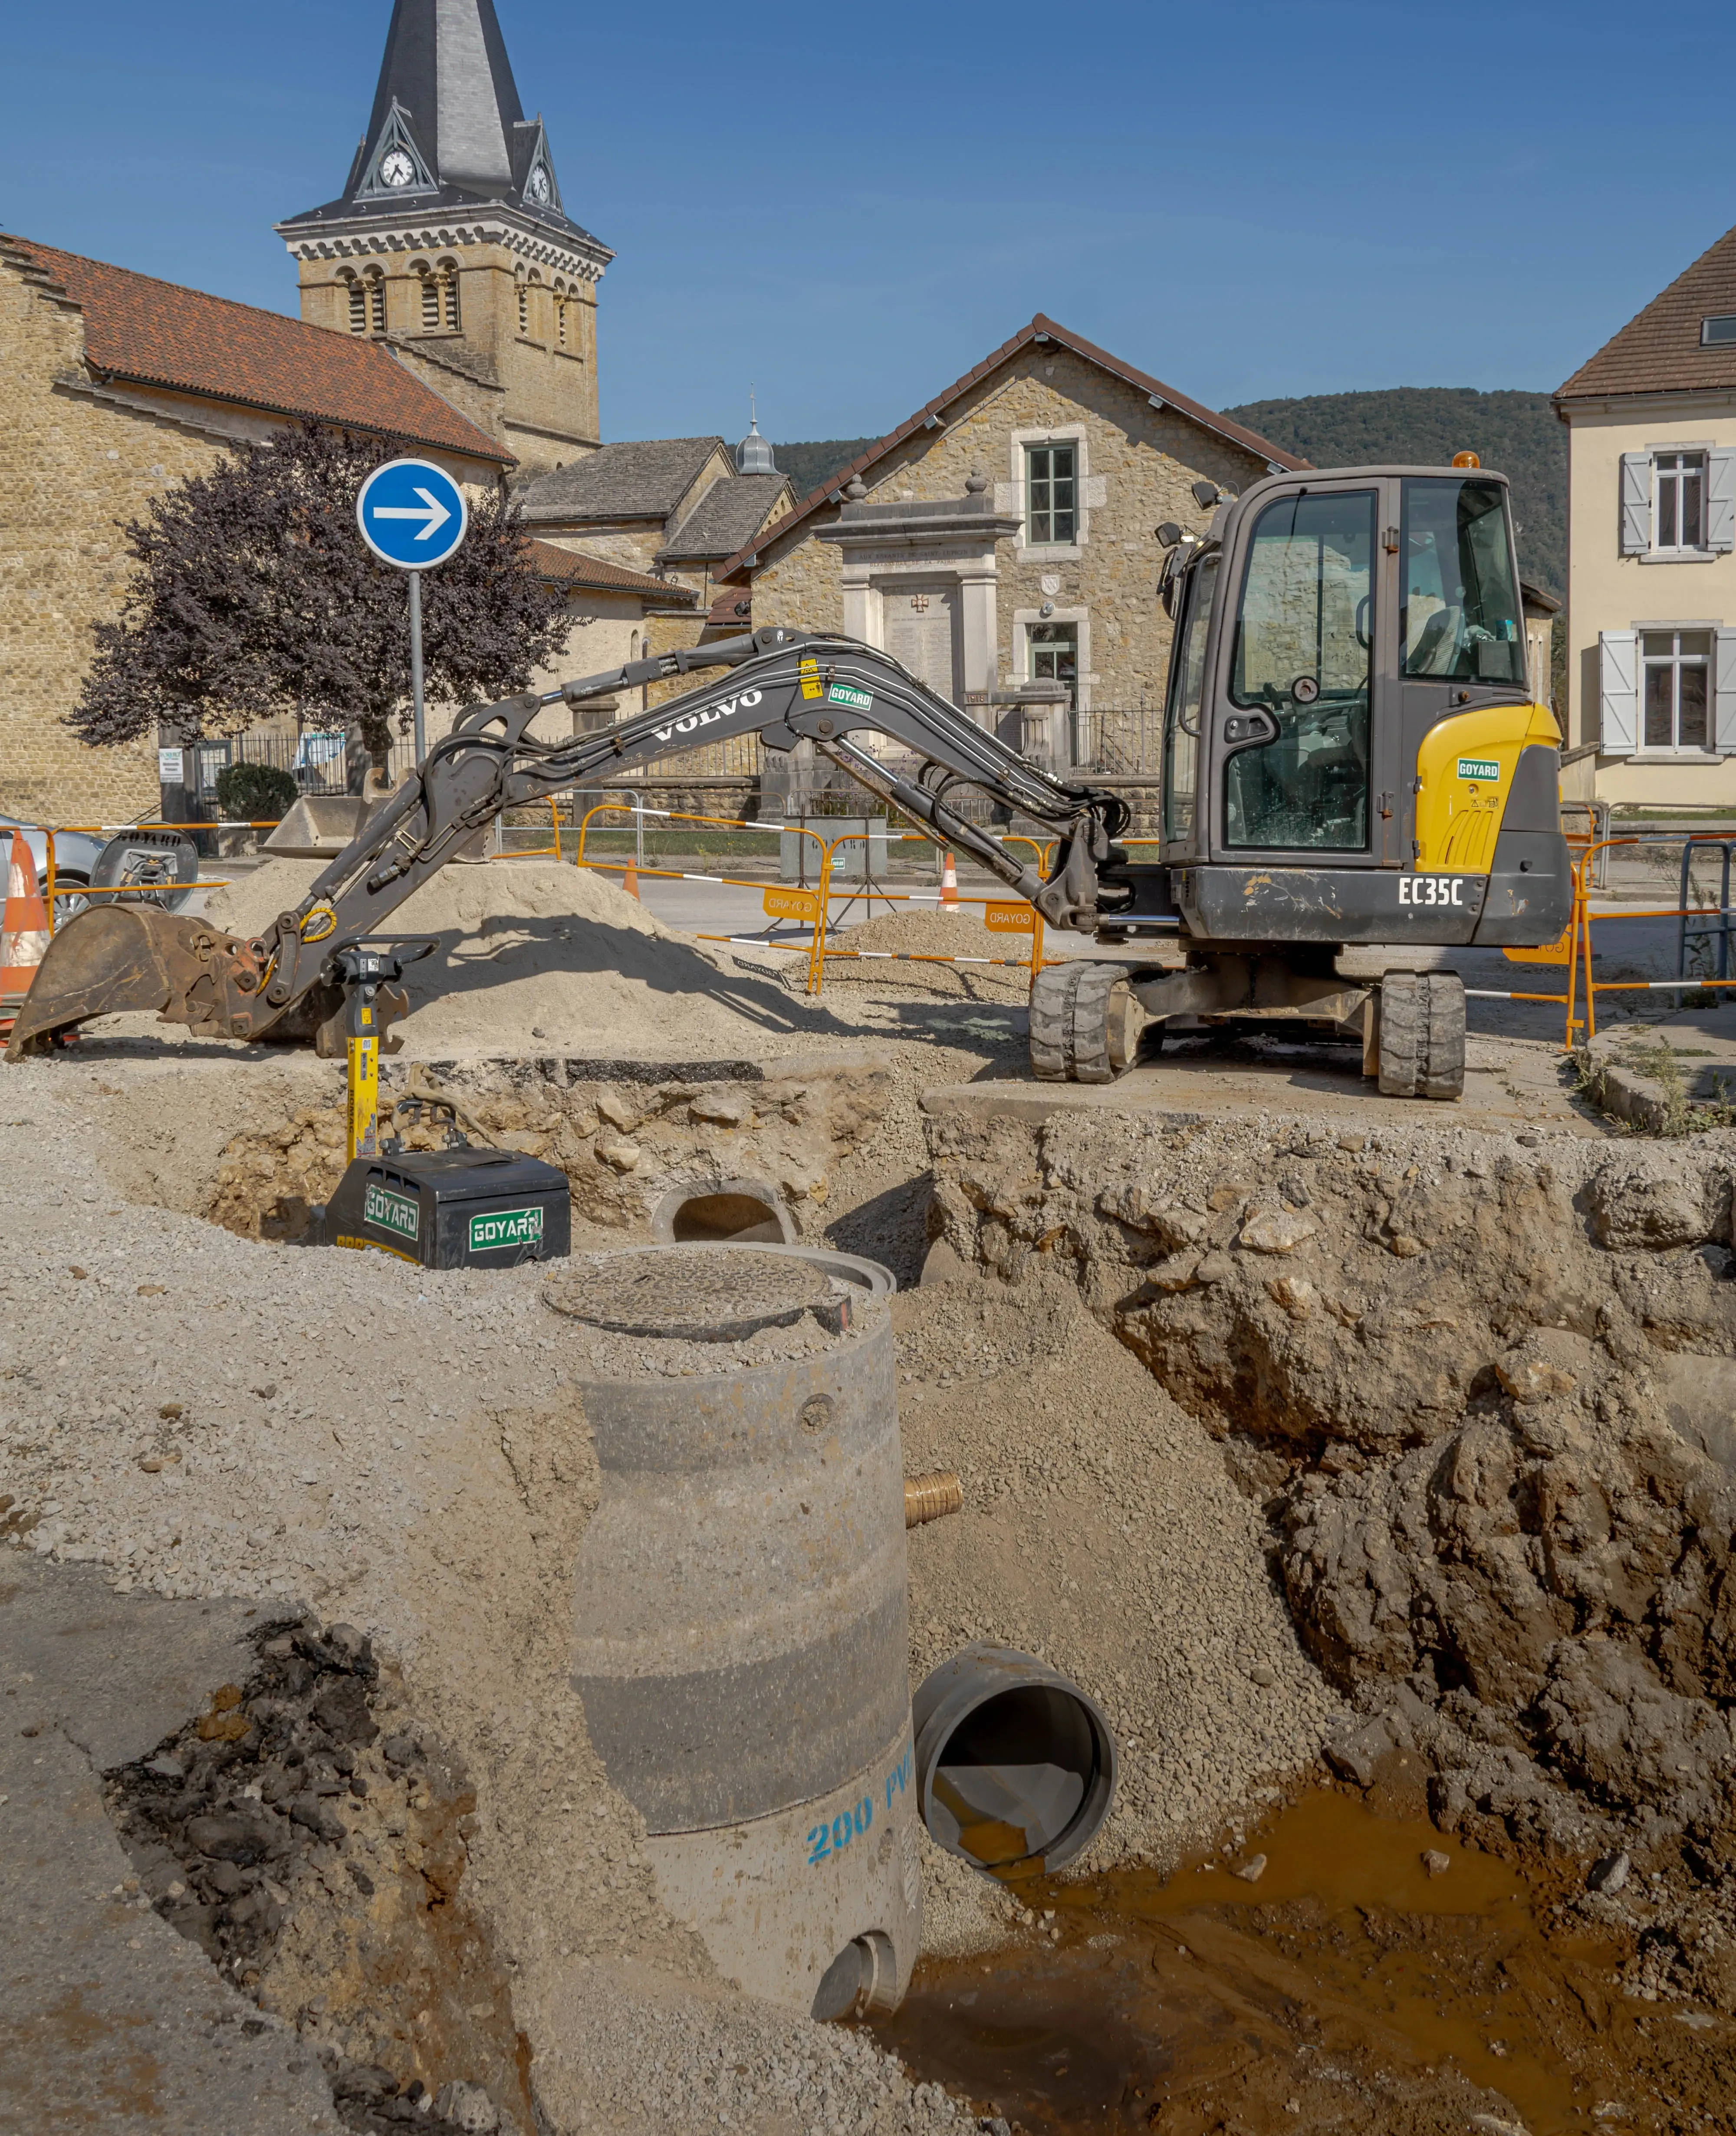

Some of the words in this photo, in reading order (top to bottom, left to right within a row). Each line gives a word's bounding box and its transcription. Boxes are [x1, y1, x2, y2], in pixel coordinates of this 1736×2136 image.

[831, 687, 871, 705] GOYARD
[651, 689, 760, 741] VOLVO
[1460, 763, 1497, 777] GOYARD
[1399, 877, 1463, 906] EC35C
[367, 1192, 416, 1232] GOYARD
[474, 1216, 538, 1242] GOYARD
[807, 1795, 873, 1865] 200
